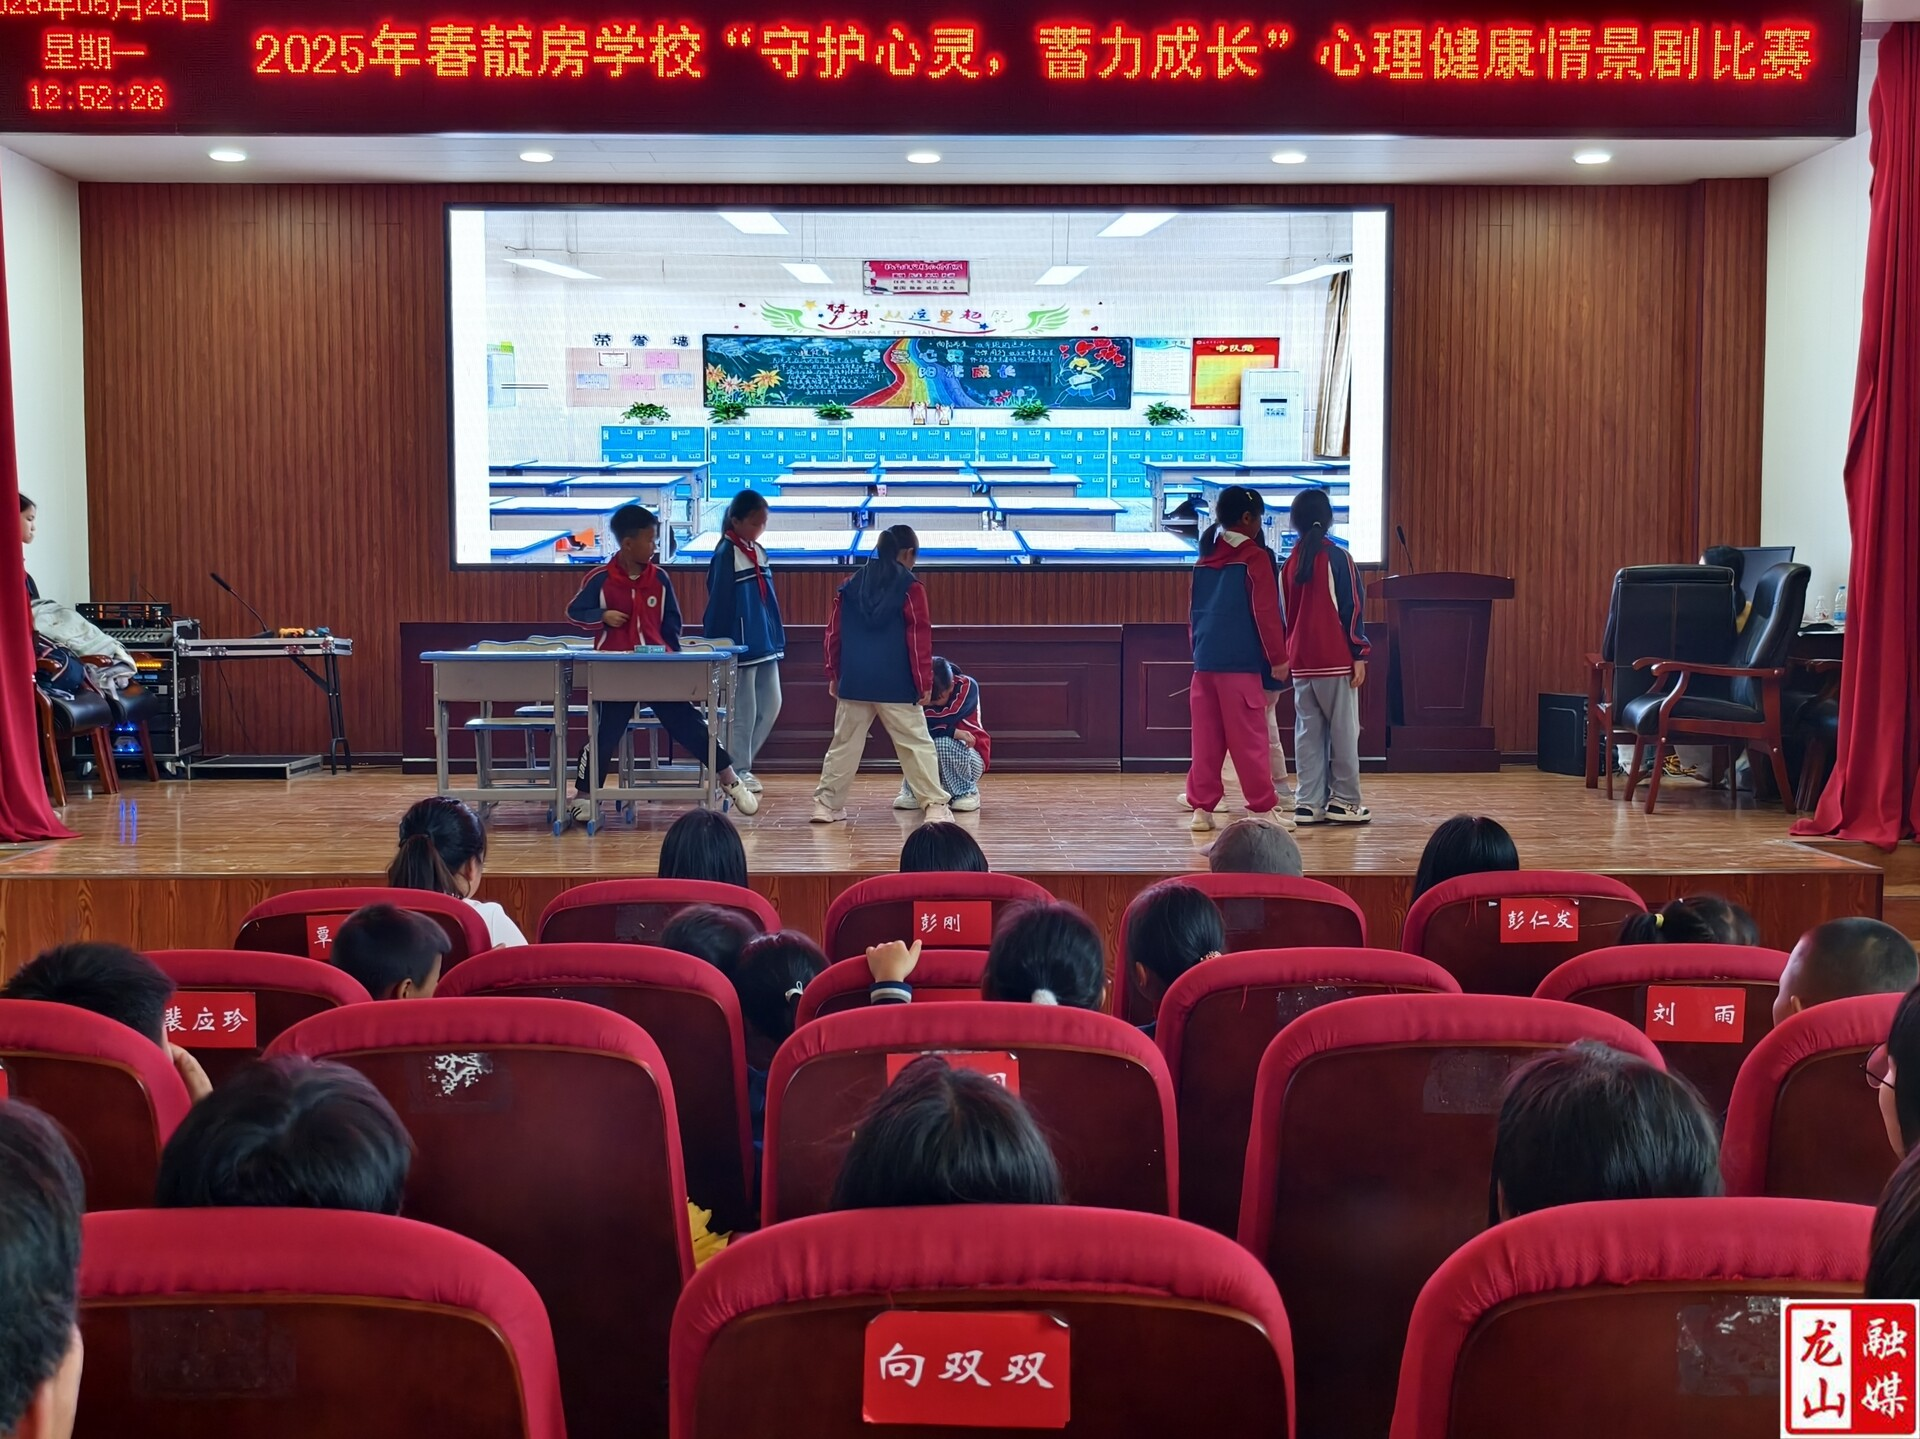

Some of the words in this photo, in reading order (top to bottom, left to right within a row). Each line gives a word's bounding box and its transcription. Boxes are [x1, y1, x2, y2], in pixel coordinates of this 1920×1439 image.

[45, 33, 145, 70] 星期一
[29, 85, 163, 110] 12:52:26
[920, 912, 961, 934] 彭刚
[1507, 910, 1574, 930] 彭仁发
[879, 1342, 1055, 1390] 向双双
